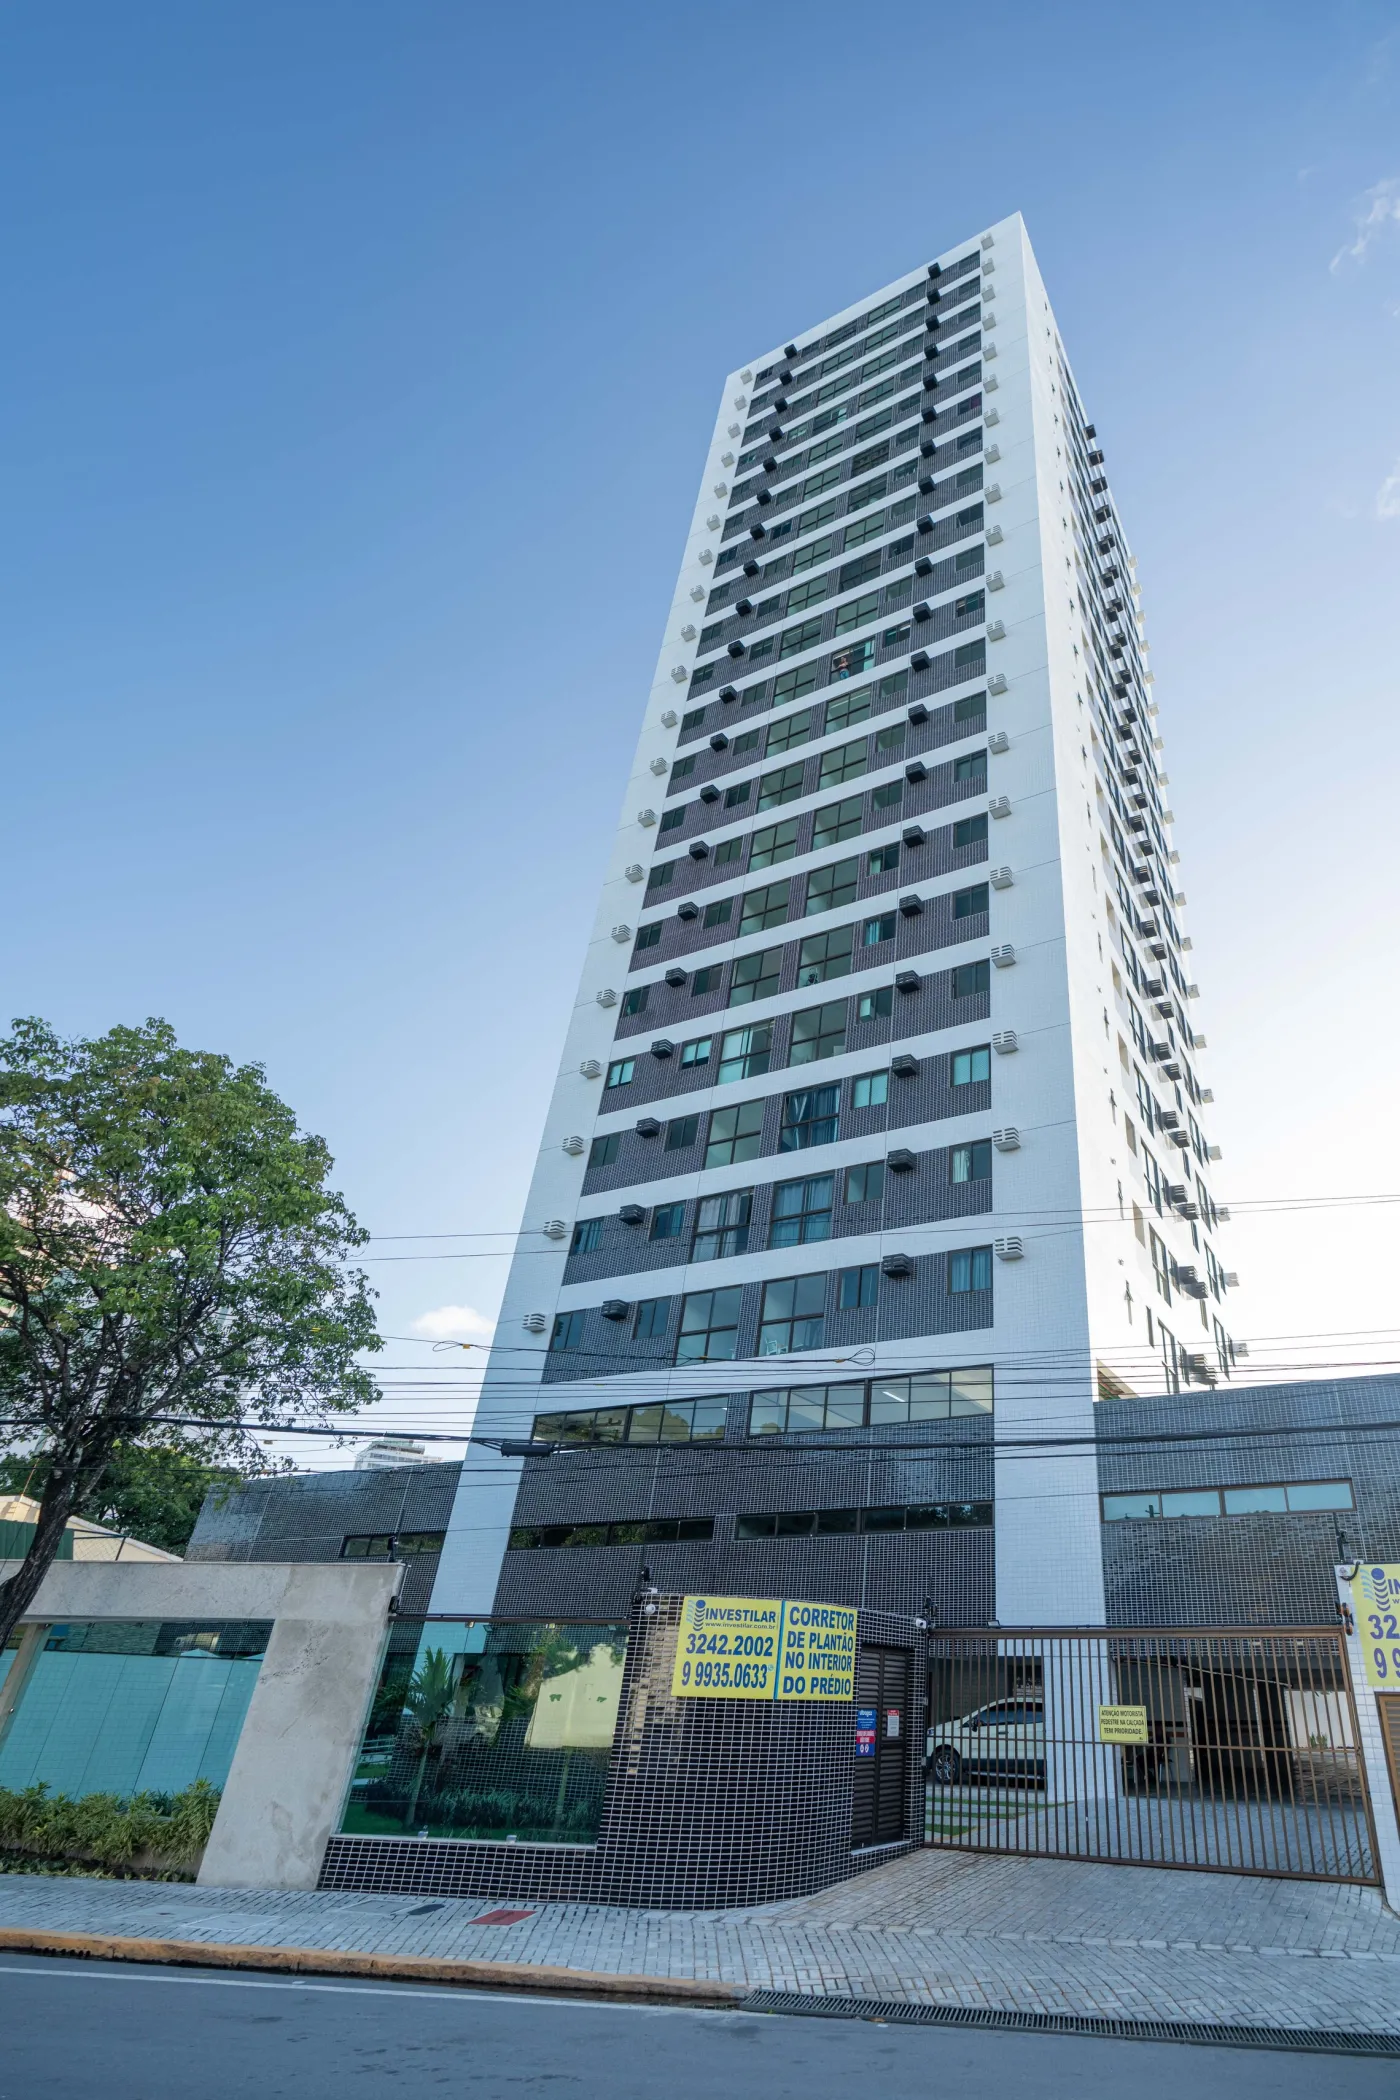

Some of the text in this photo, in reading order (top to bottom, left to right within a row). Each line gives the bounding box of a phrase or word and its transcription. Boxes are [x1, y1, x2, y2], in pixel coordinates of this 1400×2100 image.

[705, 1608, 776, 1623] INVESTILAR
[705, 1621, 776, 1630] www.investilar.com.br
[789, 1606, 855, 1631] CORRETOR
[1368, 1615, 1400, 1639] 32
[686, 1633, 774, 1657] 3242.2002
[787, 1630, 854, 1653] DE PLANTÃO
[785, 1651, 852, 1672] NO INTERIOR
[1374, 1648, 1387, 1678] 9
[682, 1661, 768, 1689] 9 9935.0633
[783, 1673, 852, 1696] DO PRÉDIO
